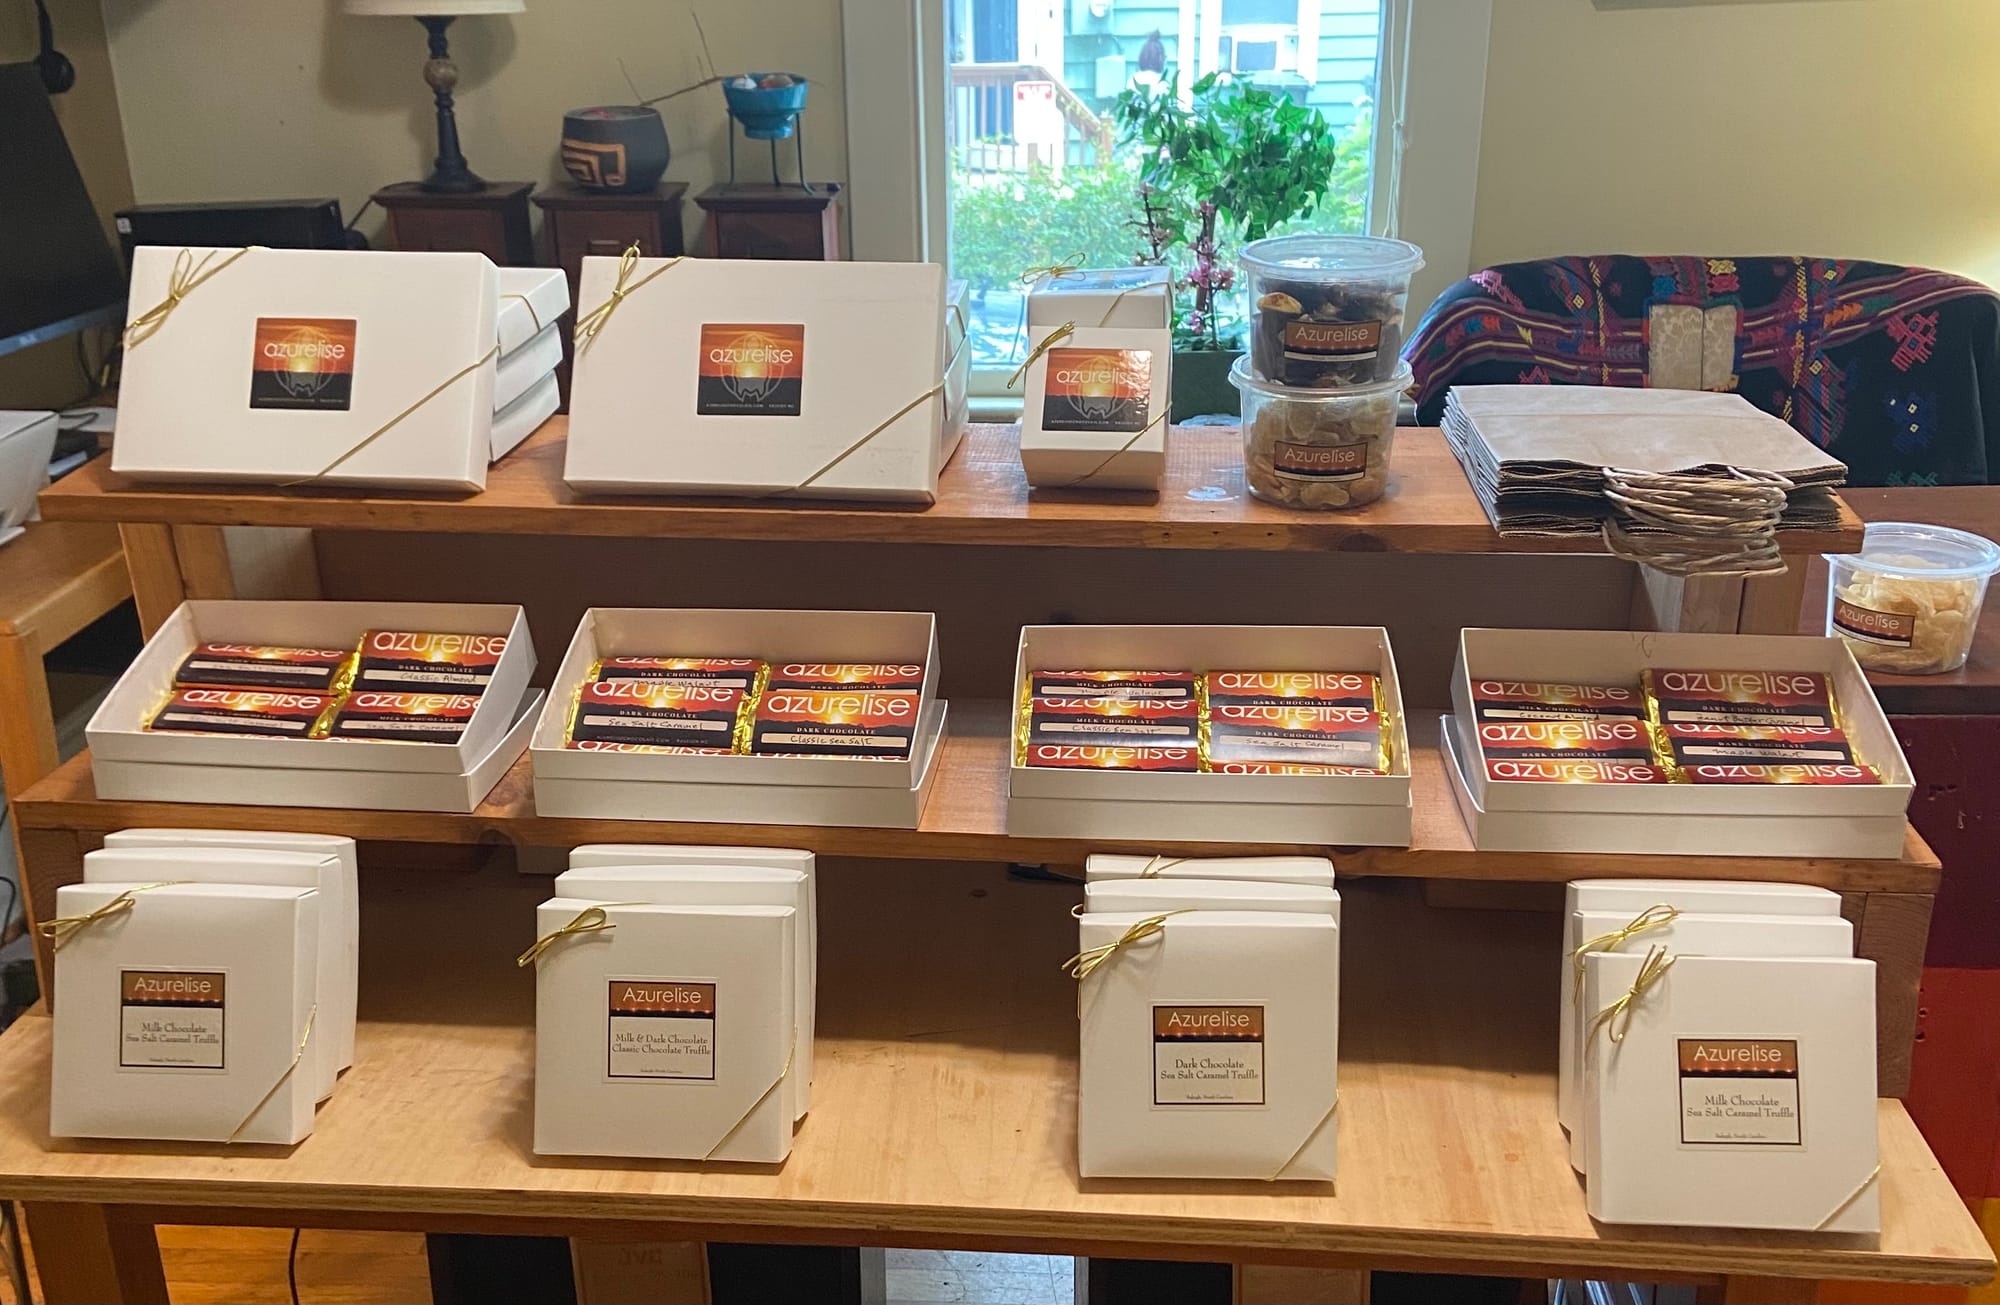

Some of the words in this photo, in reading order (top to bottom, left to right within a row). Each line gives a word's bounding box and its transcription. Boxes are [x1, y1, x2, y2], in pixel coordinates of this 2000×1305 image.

[1295, 327, 1369, 342] Azurelise
[264, 340, 345, 359] azurelise
[710, 345, 793, 364] azurelise
[1284, 447, 1355, 463] Azurelise
[1839, 605, 1900, 629] Azurelise
[374, 632, 508, 655] azurelise
[424, 665, 473, 673] CHOCOLATE
[783, 664, 920, 677] azurelise
[1218, 673, 1362, 690] azurelise
[1663, 672, 1815, 696] azurelise
[593, 681, 733, 702] azurelise
[1480, 680, 1629, 700] azurelise
[183, 690, 321, 709] azurelise
[768, 694, 910, 717] azurelise
[645, 711, 698, 719] CHOCOLATE
[1222, 706, 1370, 723] azurelise
[1730, 706, 1787, 714] CHOCOLATE
[1482, 721, 1637, 741] azurelise
[1037, 745, 1188, 760] azurelise
[1493, 761, 1654, 781] azurelise
[1697, 765, 1863, 778] azurelise
[134, 977, 212, 993] Azurelise
[622, 987, 702, 1004] Azurelise
[1168, 1010, 1250, 1027] Azurelise
[164, 1022, 207, 1033] Chocolate
[615, 1033, 635, 1042] Milk
[636, 1034, 644, 1043] &
[646, 1034, 666, 1043] Dark
[668, 1034, 708, 1044] Chocolate
[612, 1043, 640, 1053] Classic
[641, 1044, 682, 1054] Chocolate
[683, 1045, 711, 1055] Truffle
[1693, 1044, 1782, 1062] Azurelise
[1175, 1057, 1198, 1068] Dark
[1199, 1058, 1244, 1068] Chocolate
[1160, 1070, 1175, 1080] Sea
[1177, 1070, 1194, 1080] Salt
[1196, 1070, 1229, 1080] Caramel
[1231, 1069, 1259, 1080] Truffle
[1704, 1094, 1728, 1106] Milk
[1730, 1094, 1780, 1106] Chocolate
[1687, 1107, 1702, 1117] Sea
[1705, 1107, 1723, 1117] Salt
[1725, 1107, 1761, 1118] Caramel
[1763, 1107, 1794, 1118] Truffle
